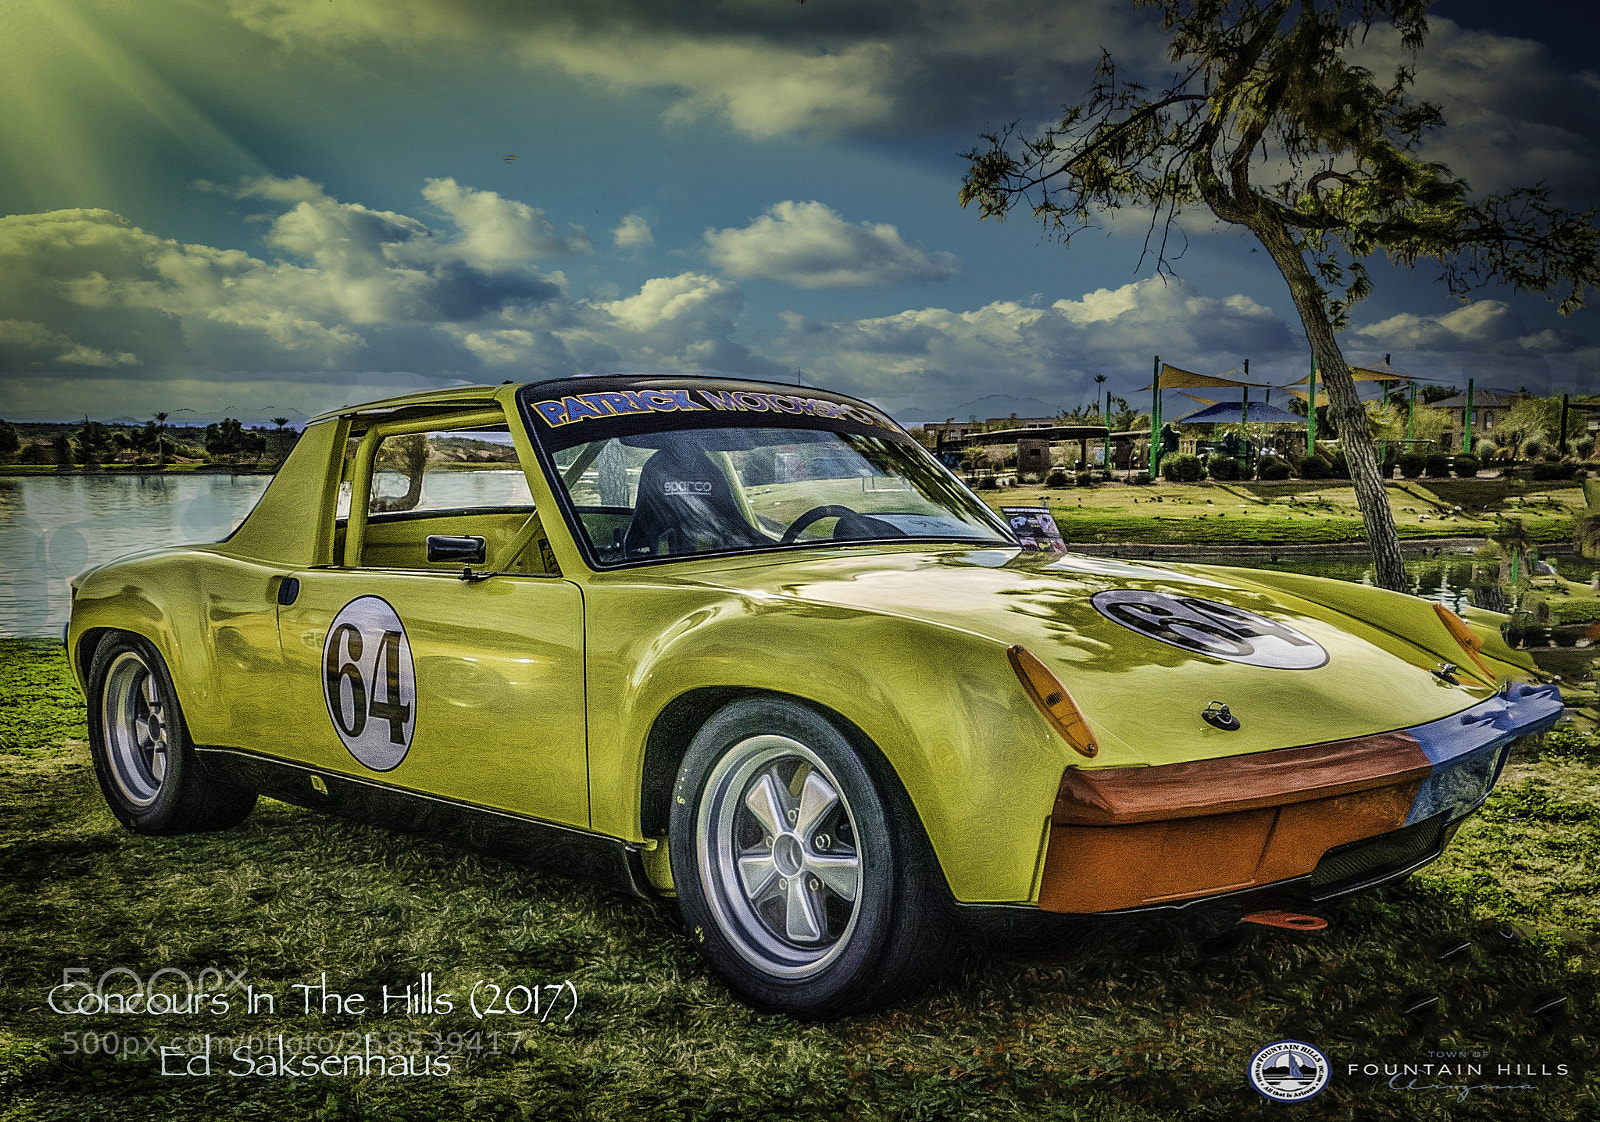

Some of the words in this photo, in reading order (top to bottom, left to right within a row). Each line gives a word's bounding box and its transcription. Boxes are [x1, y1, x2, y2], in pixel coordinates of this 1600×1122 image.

[531, 389, 711, 428] PATRICK
[697, 390, 902, 434] MOTORSPO
[664, 481, 712, 493] sparco
[1105, 598, 1314, 657] 64
[327, 622, 411, 746] 64
